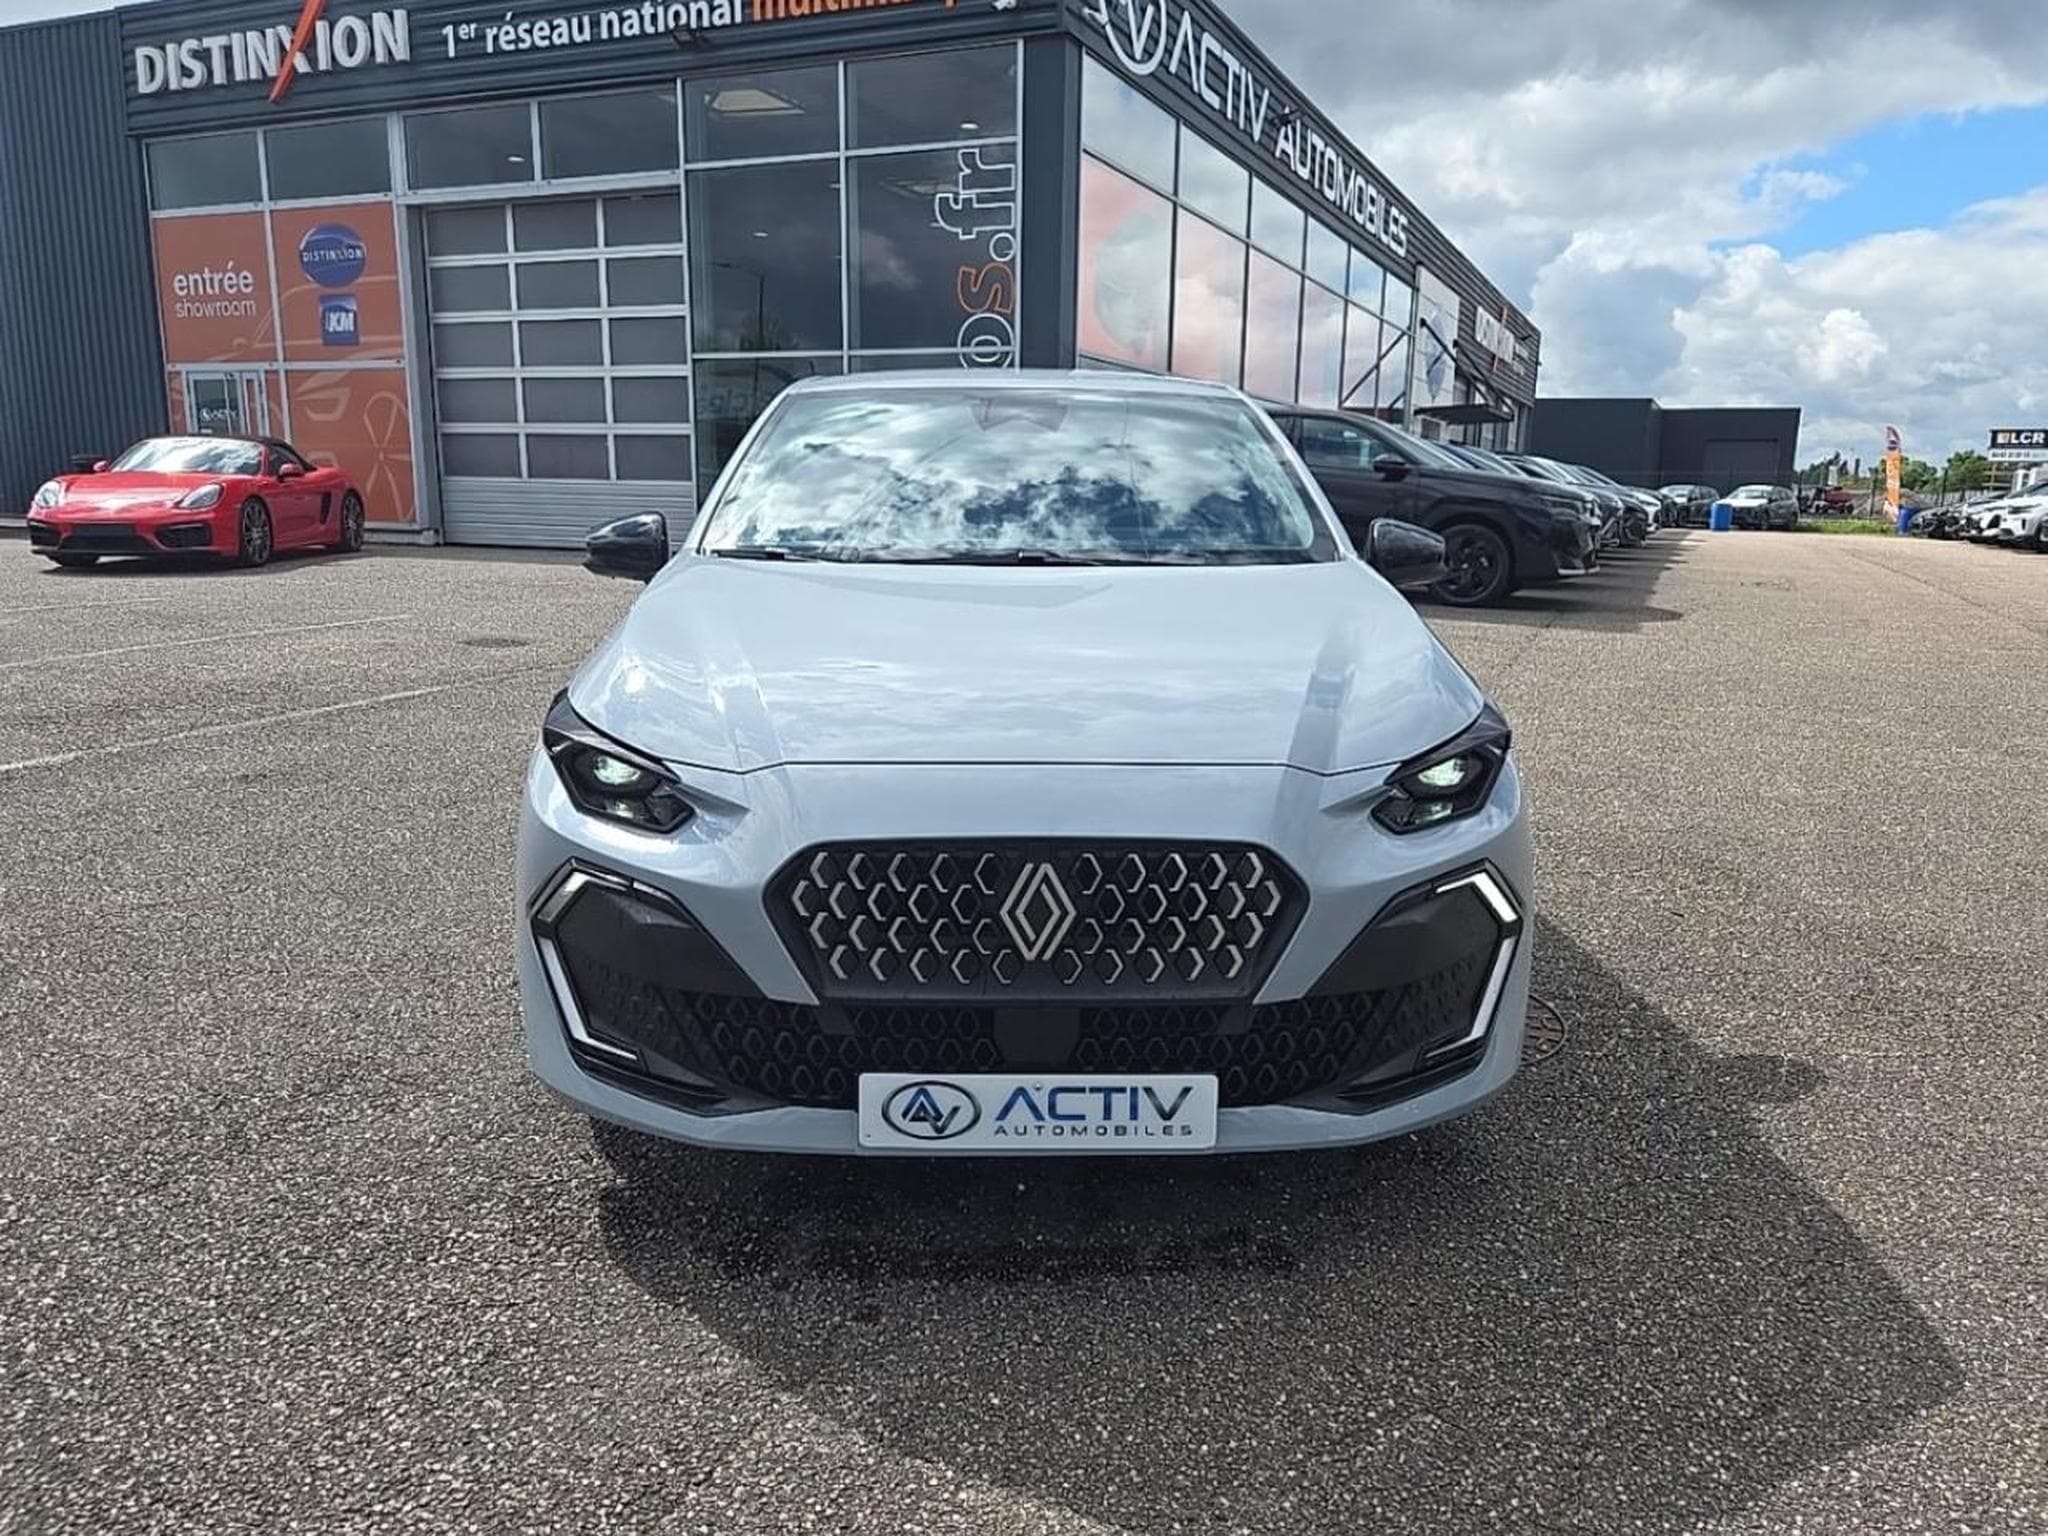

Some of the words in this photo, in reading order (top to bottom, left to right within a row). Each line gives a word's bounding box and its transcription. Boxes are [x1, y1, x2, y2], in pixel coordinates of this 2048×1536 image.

[441, 20, 477, 58] 1er
[486, 11, 591, 53] réseau
[600, 0, 742, 39] national
[135, 2, 411, 100] DISTINXION
[1168, 10, 1270, 143] ACTIV
[1274, 107, 1408, 258] AUTOMOBILES
[173, 261, 254, 296] entrée
[175, 299, 257, 319] showroom
[995, 1086, 1194, 1122] ACTIV
[995, 1125, 1194, 1138] AUTOMOBILES
